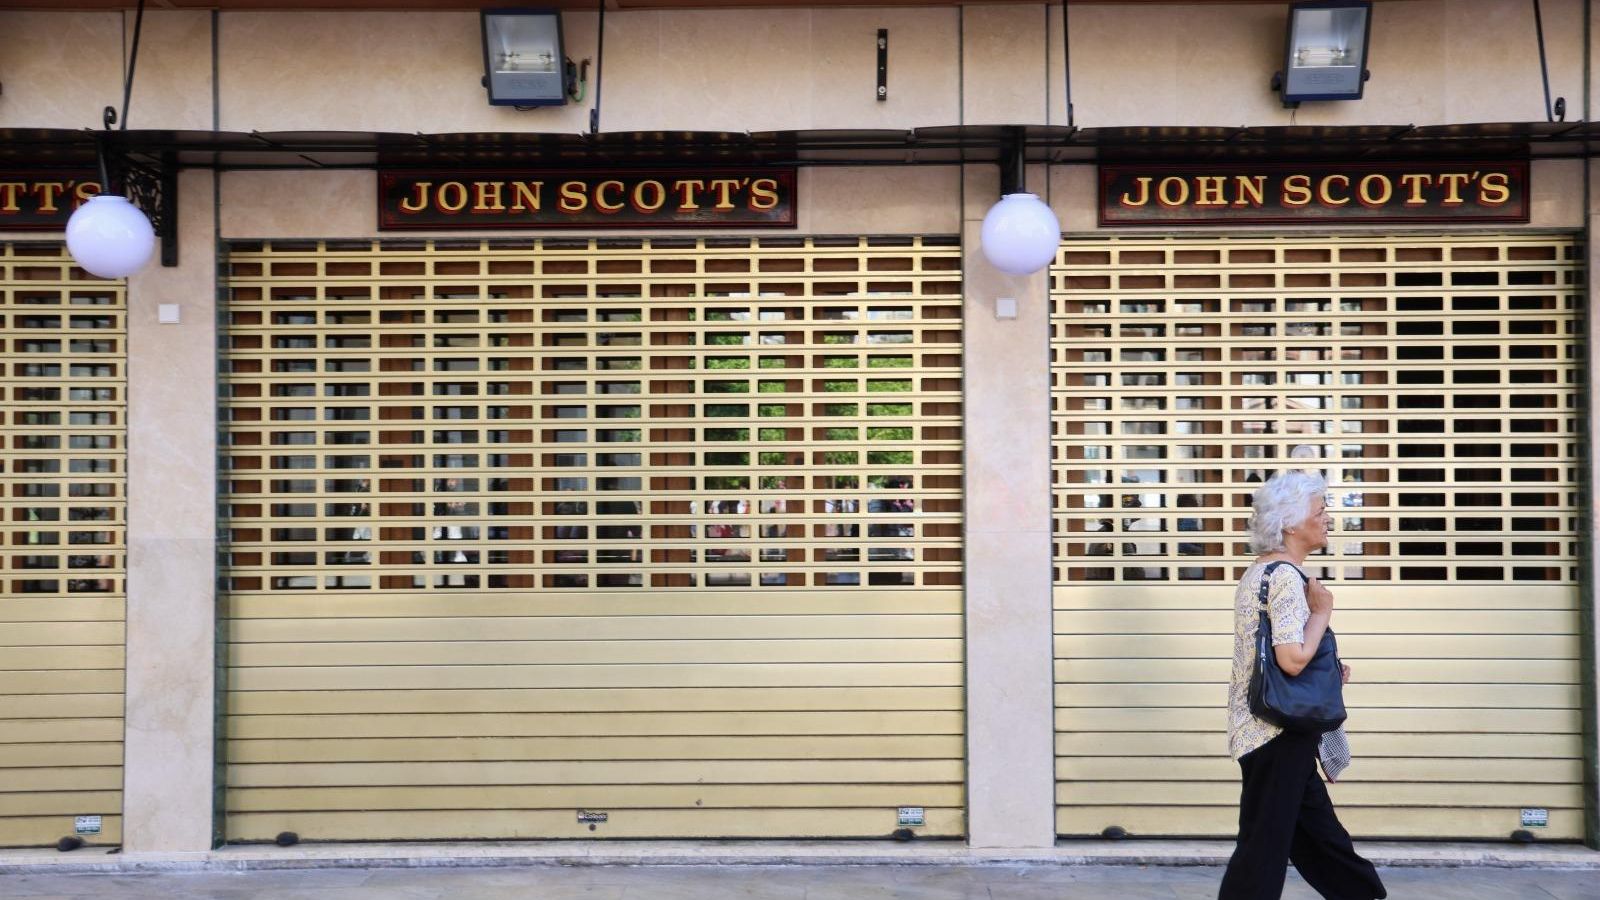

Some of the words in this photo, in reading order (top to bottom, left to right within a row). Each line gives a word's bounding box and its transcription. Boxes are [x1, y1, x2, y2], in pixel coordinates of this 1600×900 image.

[401, 181, 545, 213] JOHN
[558, 177, 780, 213] SCOTT'S
[1121, 175, 1268, 207] JOHN
[1282, 171, 1511, 207] SCOTT'S
